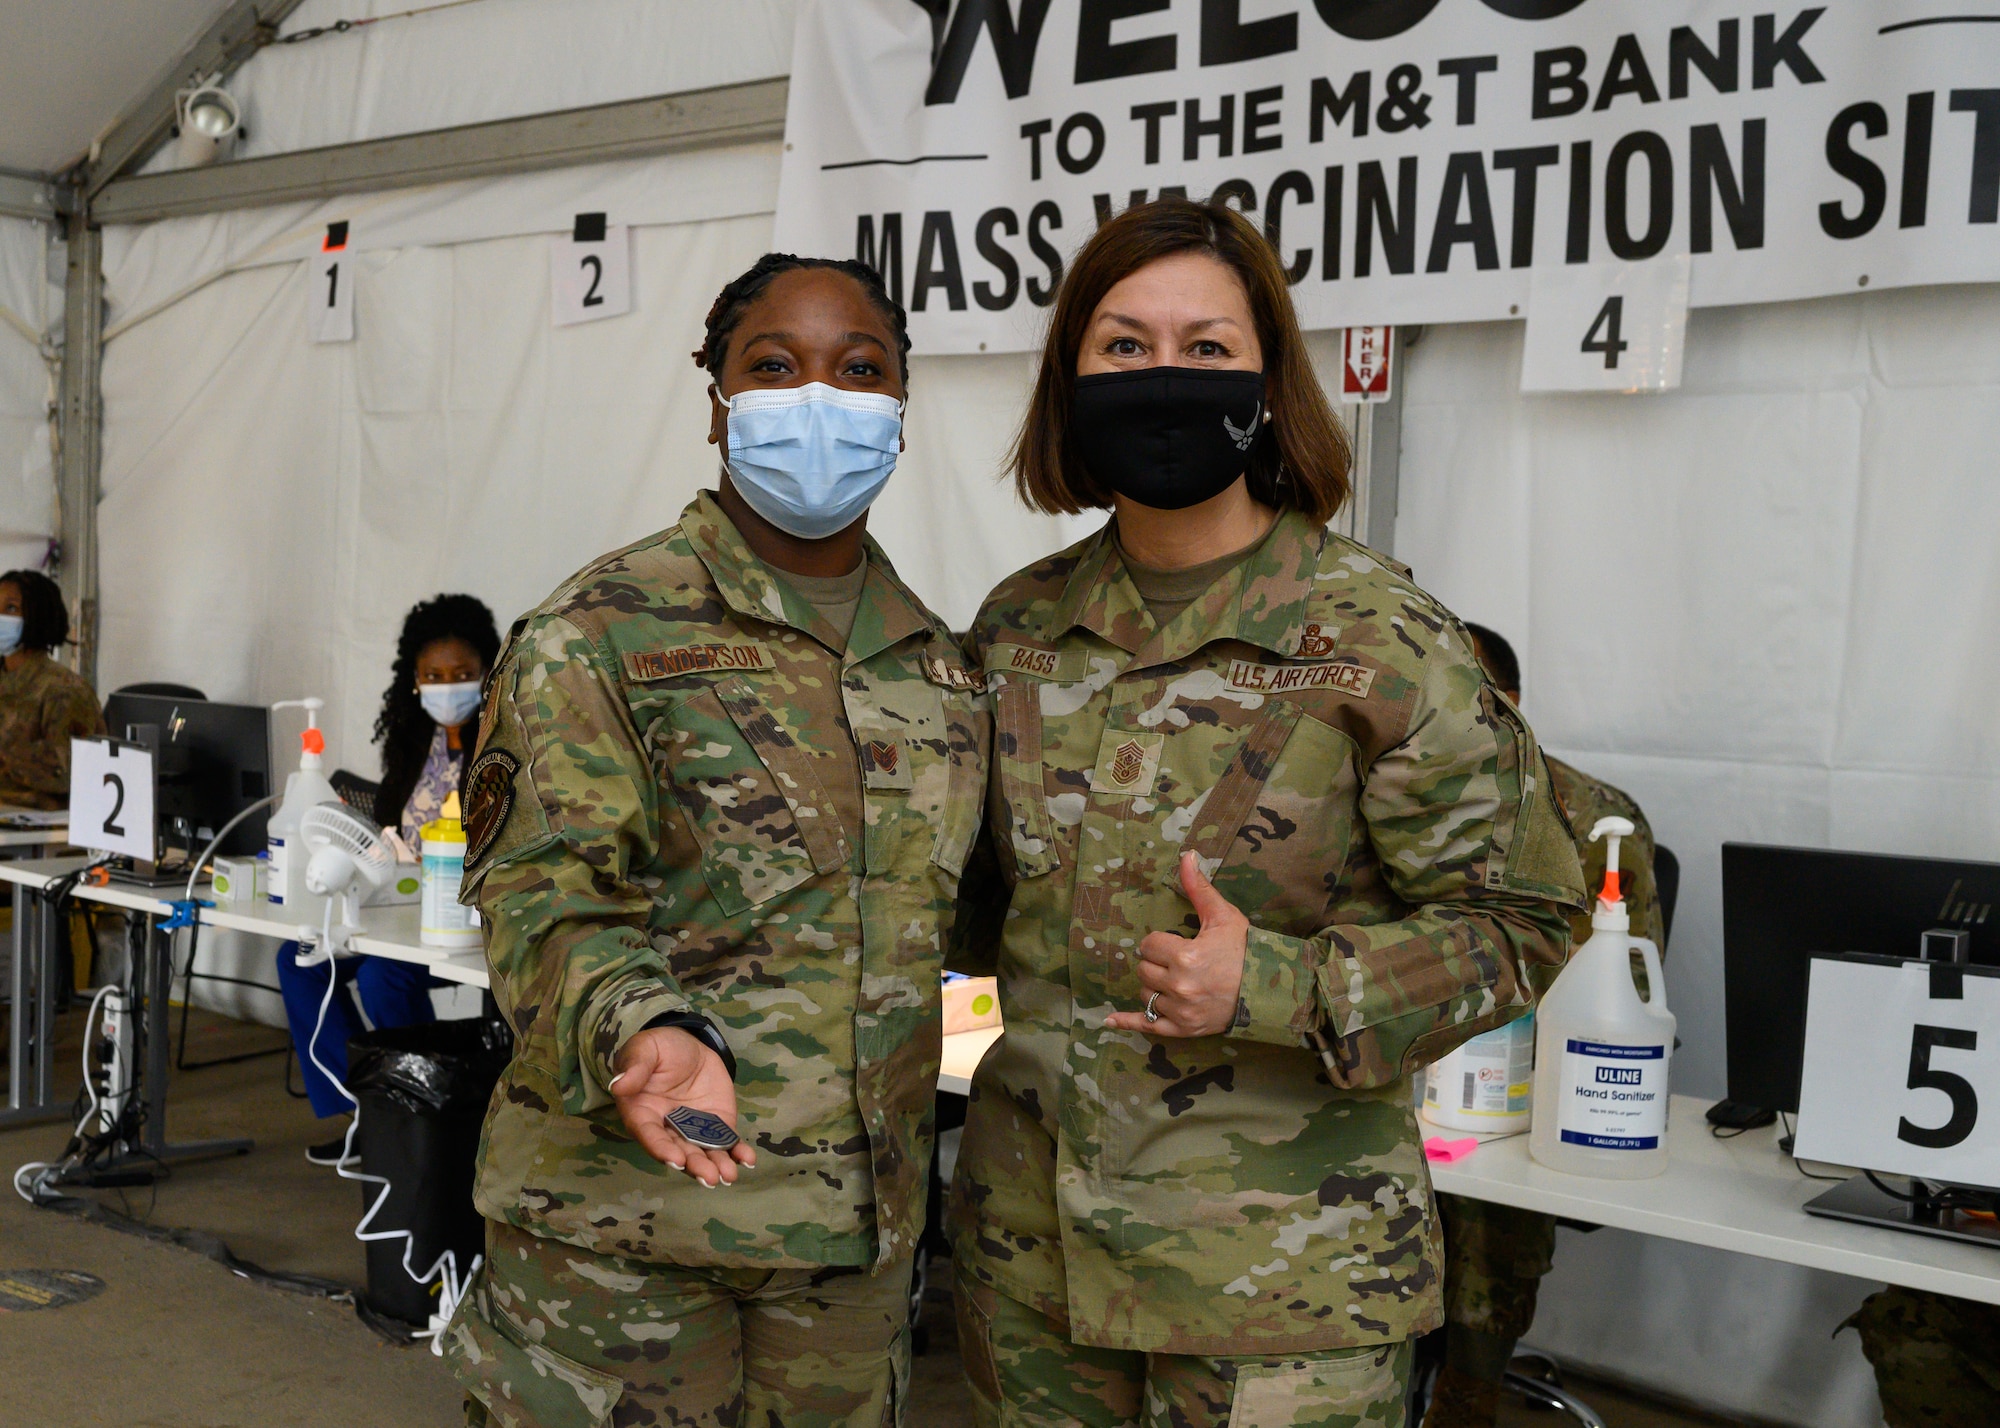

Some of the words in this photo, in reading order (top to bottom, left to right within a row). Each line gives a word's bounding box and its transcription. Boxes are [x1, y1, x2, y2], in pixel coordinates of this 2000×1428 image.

[1020, 112, 1106, 181] TO
[1130, 85, 1284, 165] THE
[1309, 54, 1498, 144] M&T
[1531, 7, 1828, 120] BANK
[856, 199, 1063, 312] MASS
[1093, 118, 1767, 287] CINATION
[1819, 88, 2000, 240] SIT
[325, 262, 339, 308] 1
[580, 253, 604, 308] 2
[1580, 295, 1628, 370] 4
[634, 645, 763, 678] HENDERSON
[1010, 647, 1056, 675] BASS
[1232, 663, 1266, 690] U.S.
[1268, 667, 1301, 690] AIR
[1300, 665, 1368, 692] FORCE
[102, 772, 125, 838] 2
[1575, 1086, 1608, 1099] Hand
[1611, 1090, 1656, 1102] Sanitizer
[1597, 1068, 1641, 1084] ULINE
[1897, 1023, 1979, 1149] 5
[1593, 1137, 1618, 1146] GALLON
